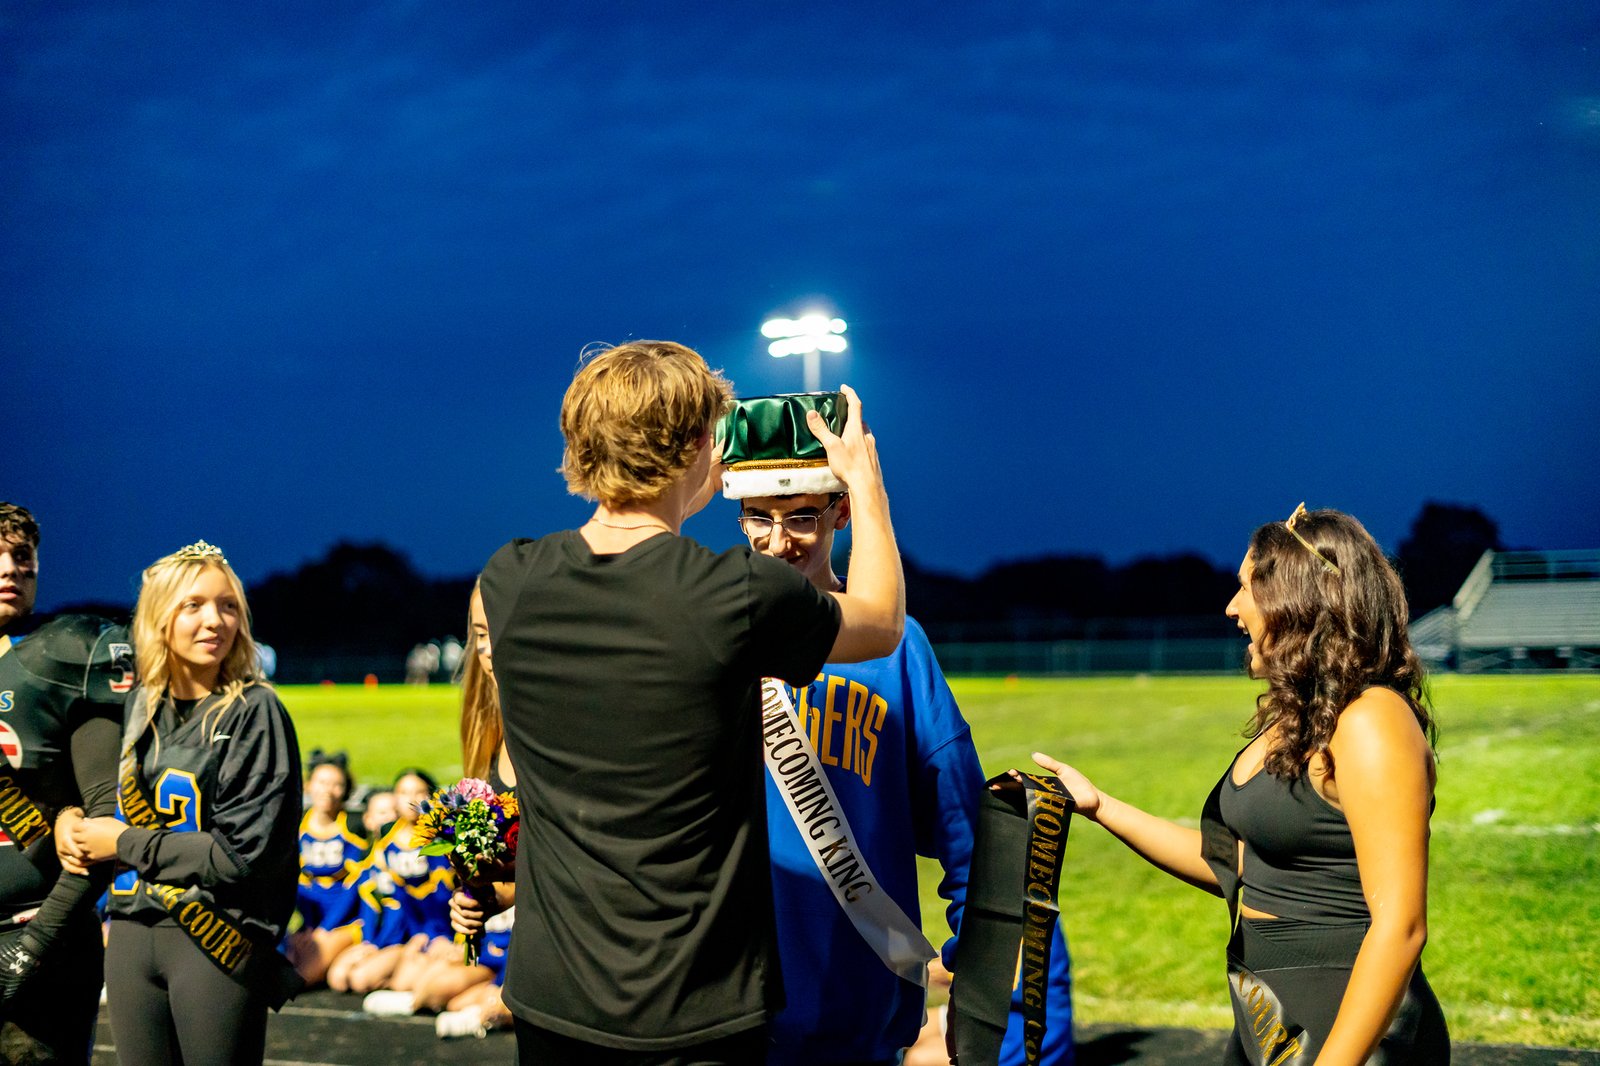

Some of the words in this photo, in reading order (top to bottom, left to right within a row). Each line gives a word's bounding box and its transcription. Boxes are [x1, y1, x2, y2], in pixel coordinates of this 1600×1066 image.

[108, 643, 136, 693] 5
[818, 835, 872, 903] KING
[1025, 789, 1066, 1008] HOMECOMING
[180, 901, 252, 969] COURT
[1239, 971, 1303, 1066] COURT
